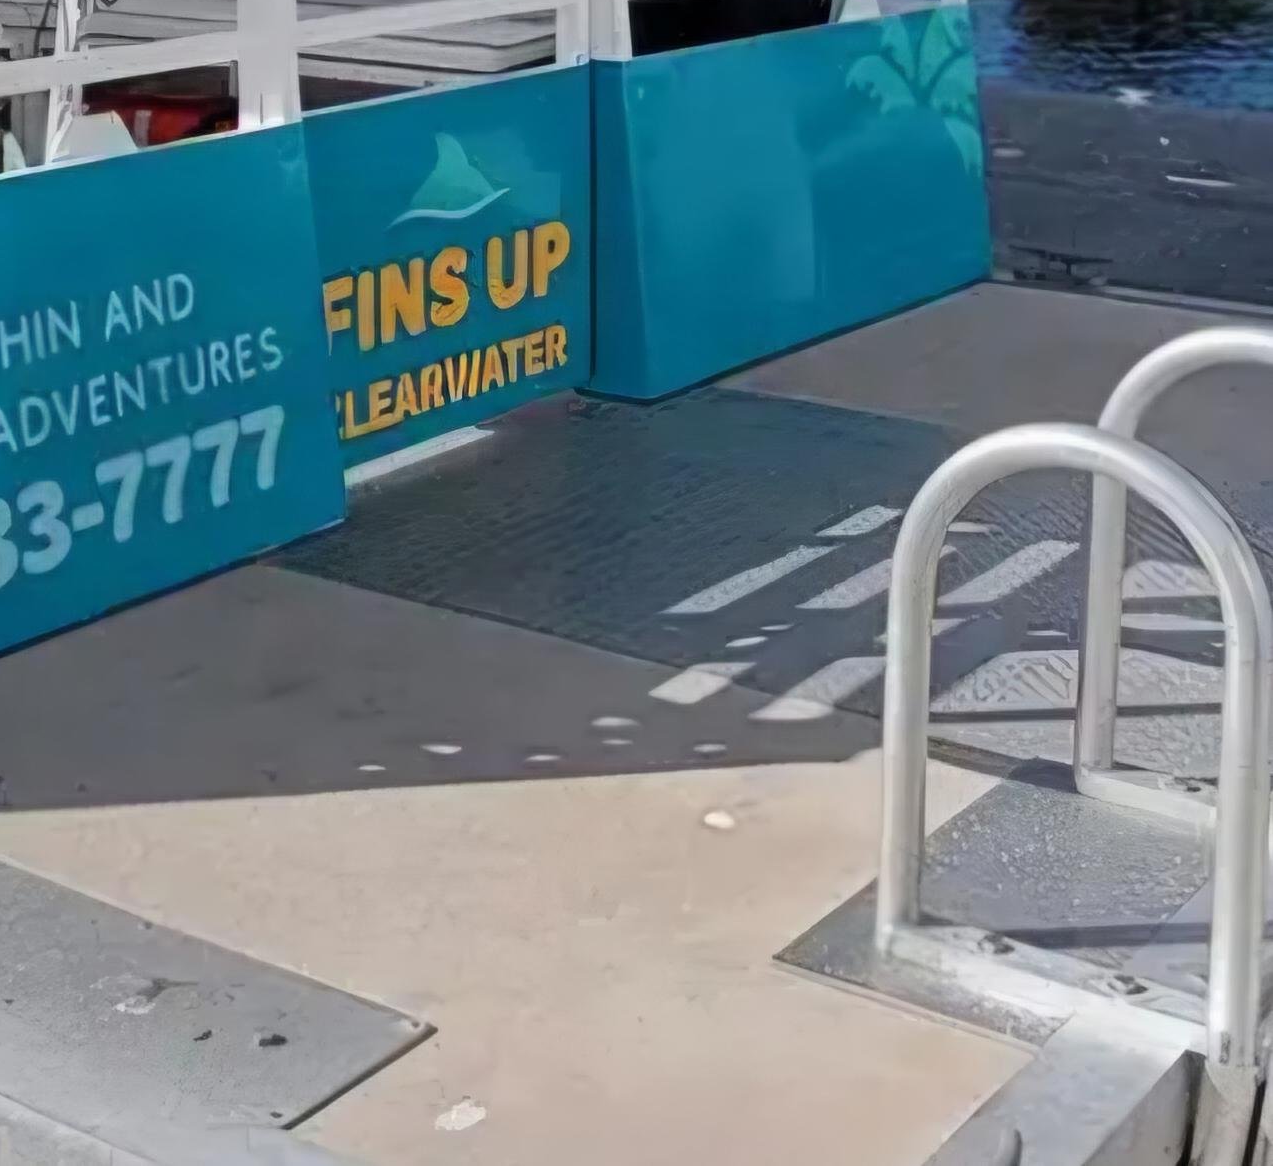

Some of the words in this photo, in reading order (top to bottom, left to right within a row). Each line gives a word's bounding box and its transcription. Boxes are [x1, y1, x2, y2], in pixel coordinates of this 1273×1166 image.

[103, 272, 195, 342] AND
[322, 246, 470, 356] FINS
[486, 220, 571, 311] UP
[334, 323, 569, 440] LEARWATER
